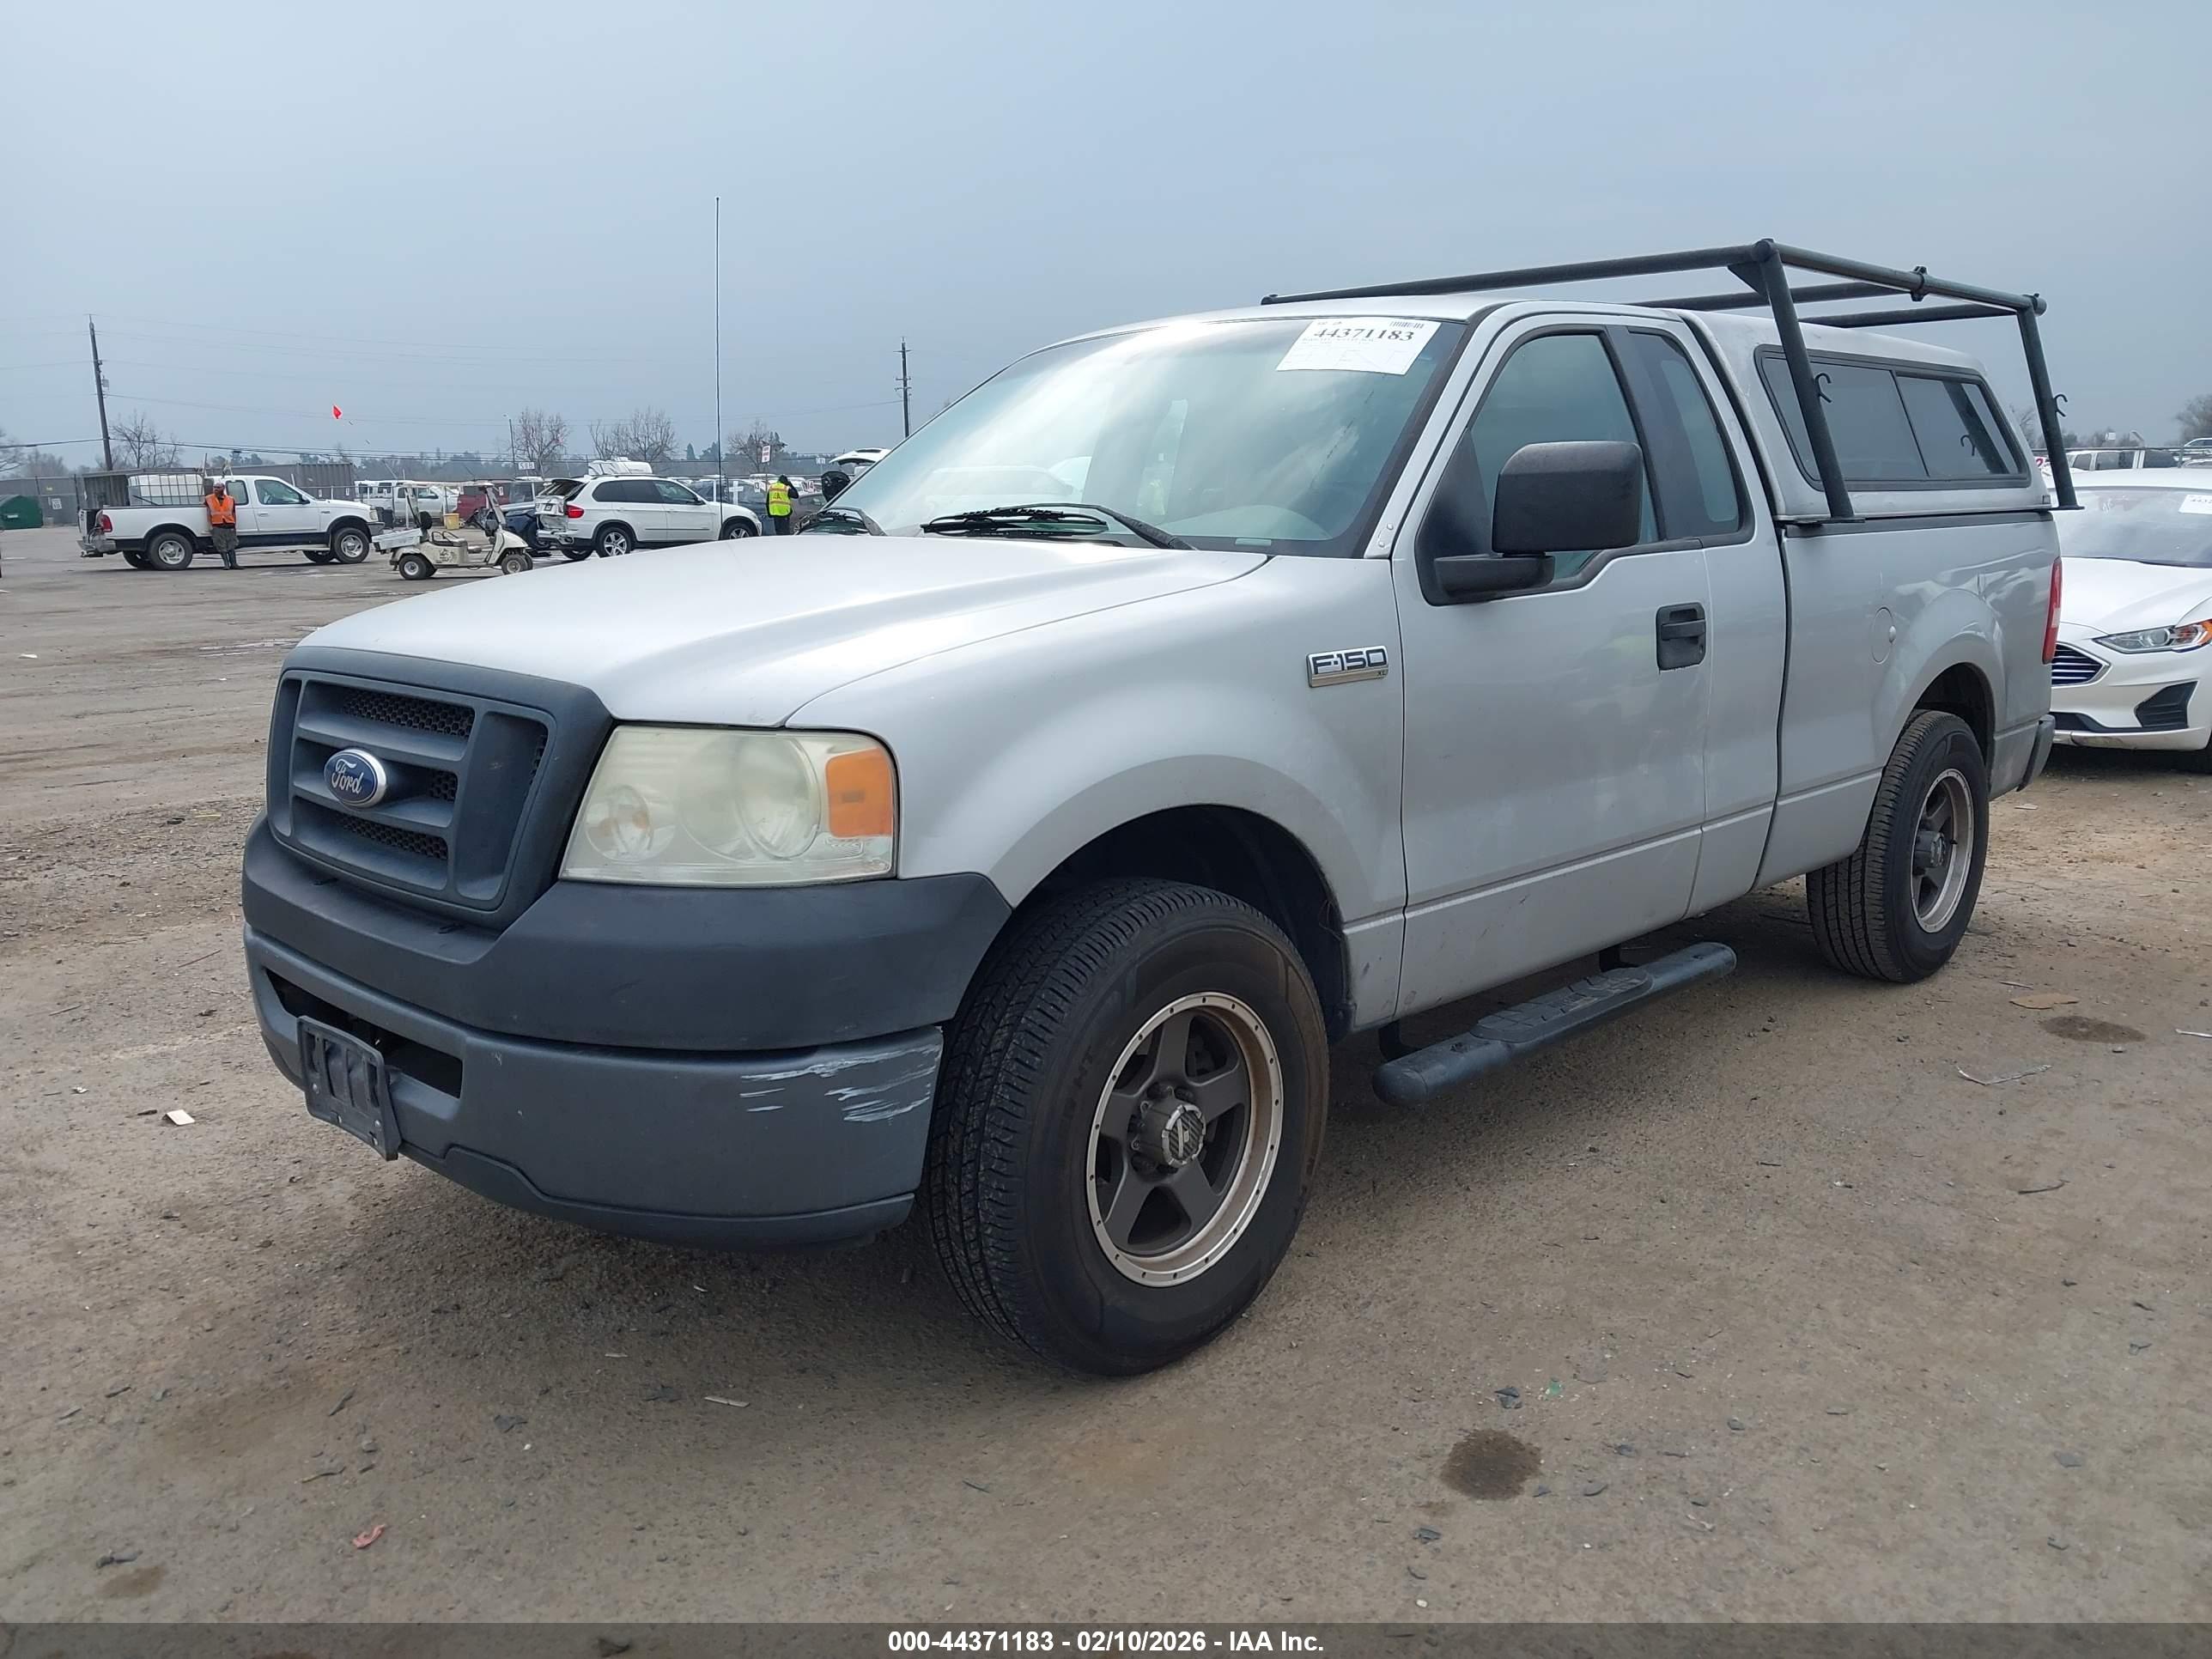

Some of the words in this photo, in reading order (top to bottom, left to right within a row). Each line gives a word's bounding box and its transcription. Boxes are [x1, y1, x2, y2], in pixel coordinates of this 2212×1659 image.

[1314, 328, 1414, 341] 44371183
[1312, 648, 1387, 674] F-150
[331, 759, 364, 793] Ford
